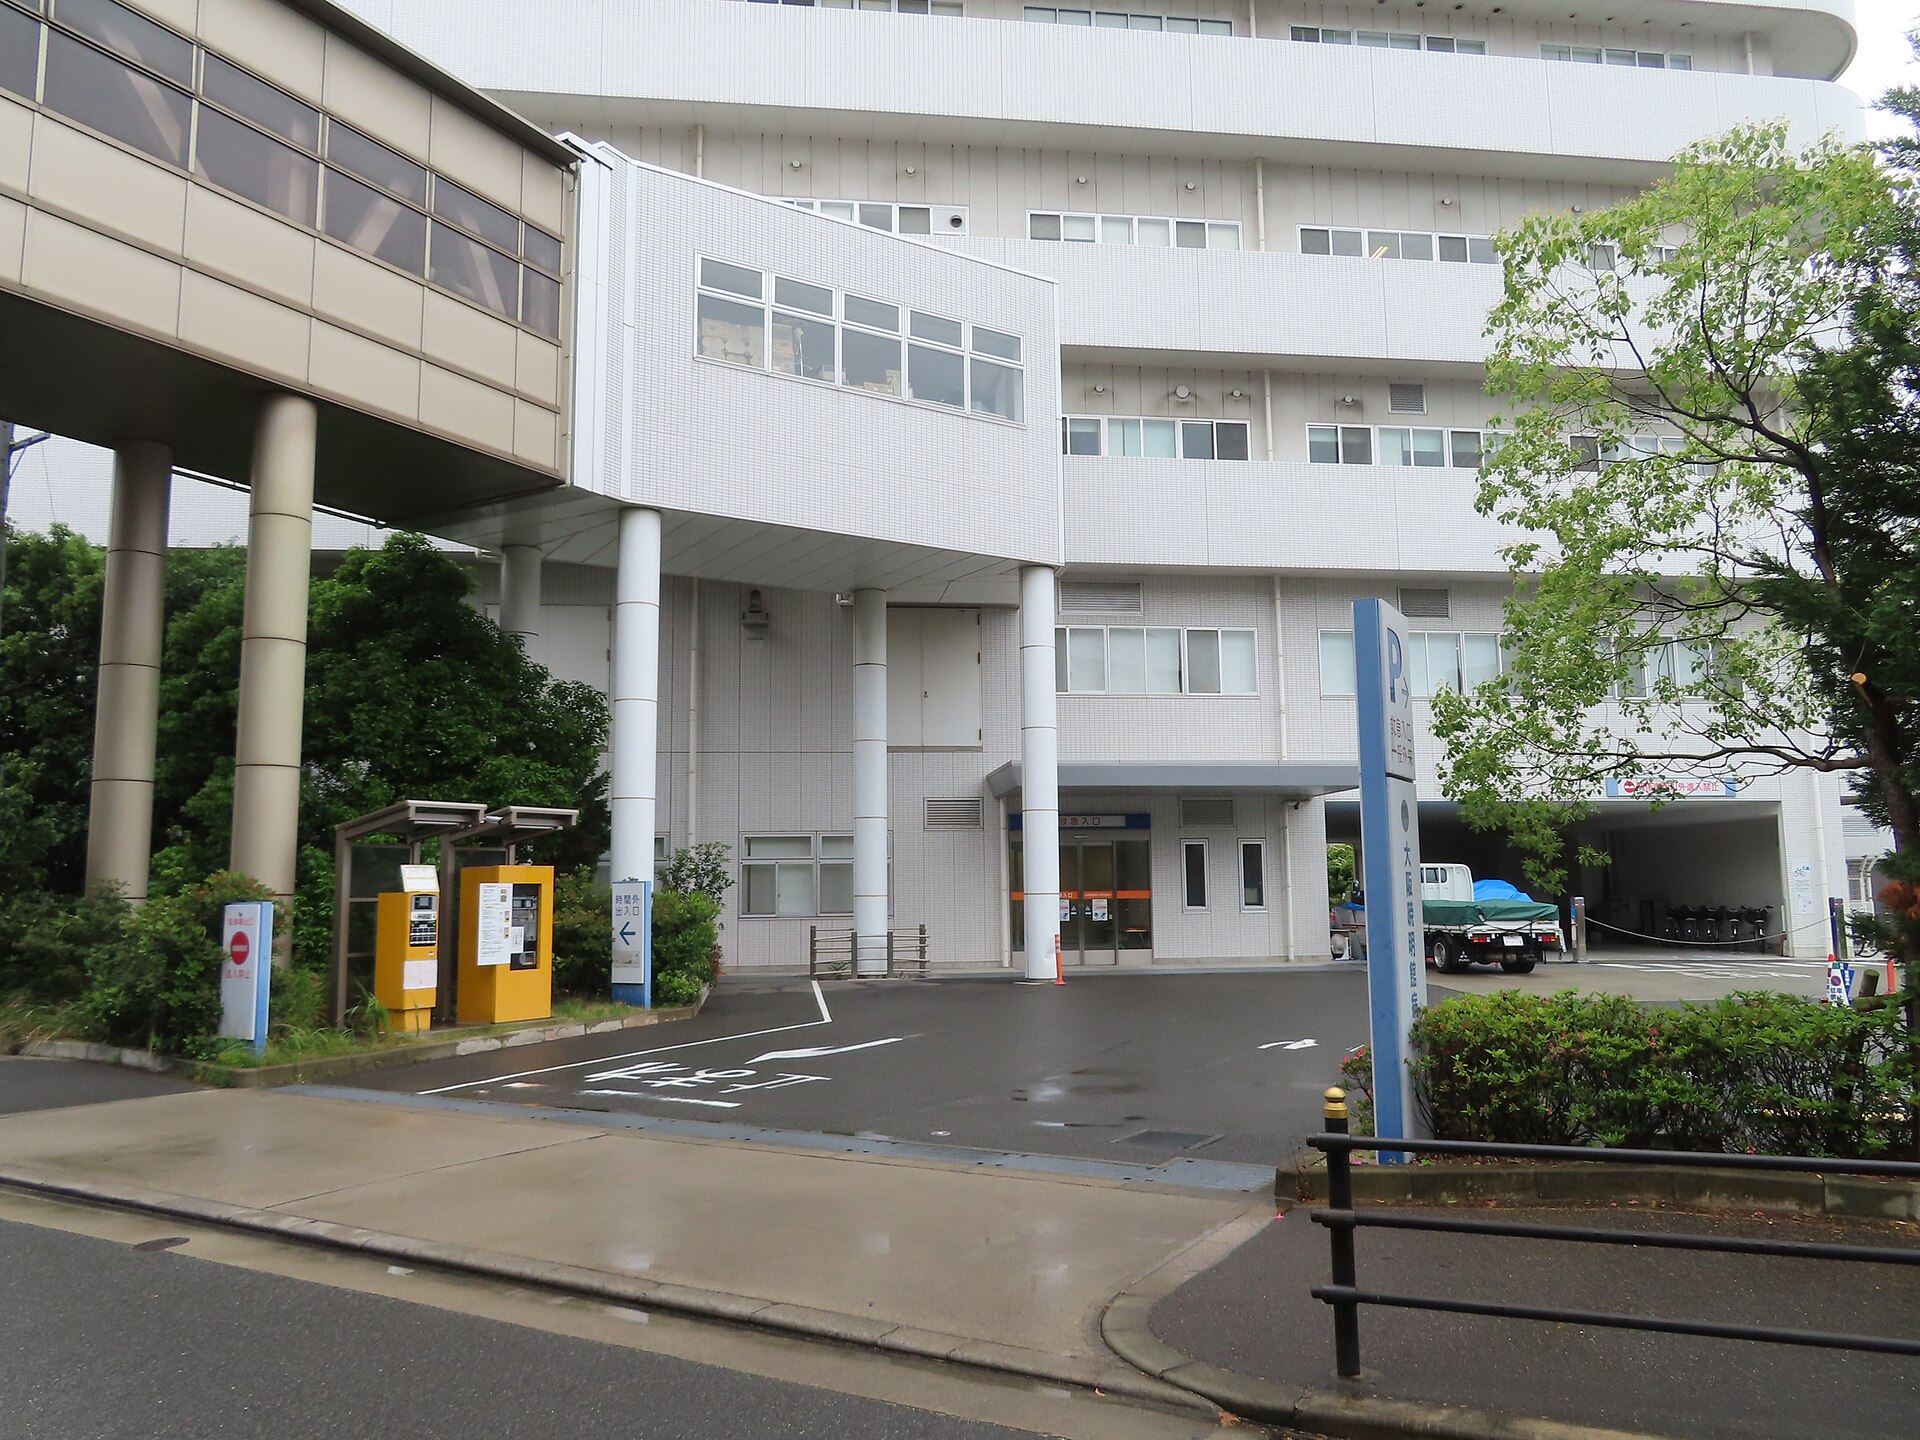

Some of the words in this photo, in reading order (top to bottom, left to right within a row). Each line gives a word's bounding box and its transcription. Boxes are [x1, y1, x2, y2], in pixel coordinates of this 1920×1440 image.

[1387, 627, 1402, 703] P
[1060, 815, 1101, 826] 救急入口
[615, 894, 640, 905] 時間外
[615, 906, 640, 917] 出入口
